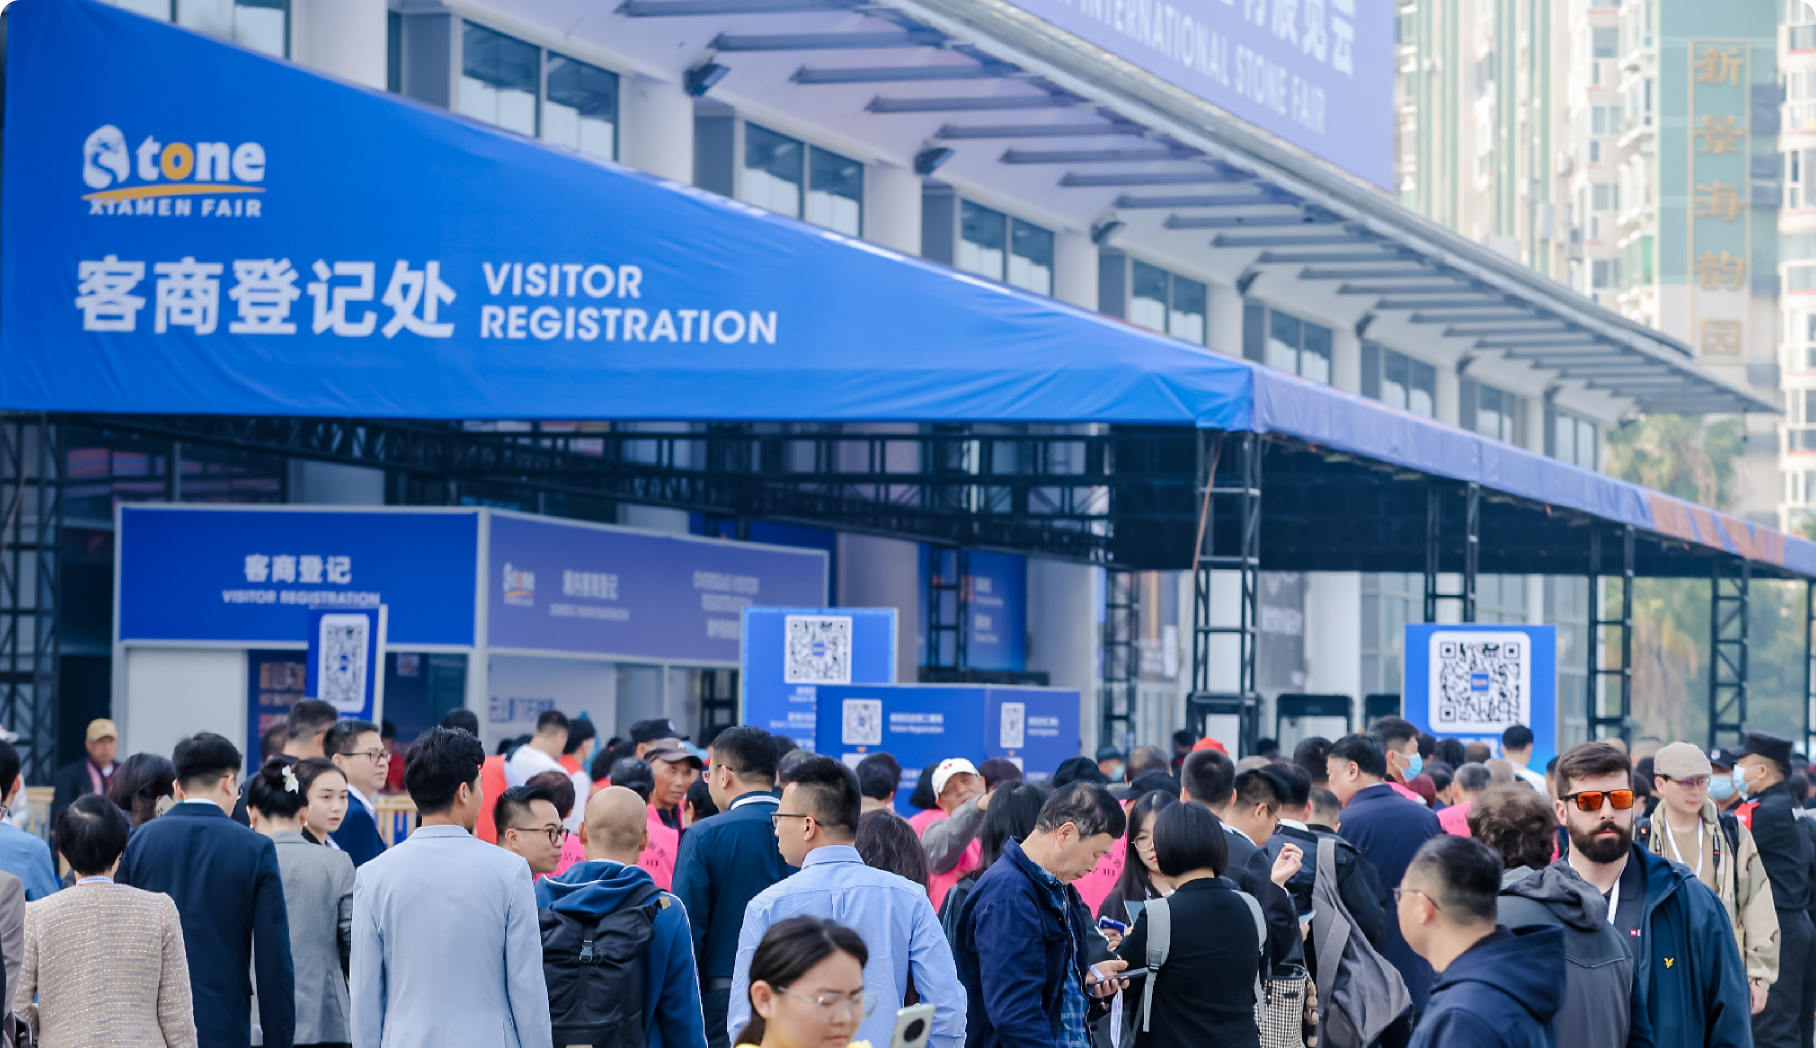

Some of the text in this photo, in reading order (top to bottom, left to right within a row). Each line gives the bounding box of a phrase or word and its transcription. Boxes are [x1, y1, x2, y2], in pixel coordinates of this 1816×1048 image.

[88, 197, 262, 218] XIAMEN FAIR
[75, 255, 456, 340] 客商登记处
[482, 261, 643, 299] VISITOR
[480, 305, 778, 345] REGISTRATION
[243, 553, 353, 585] 客商登记
[222, 589, 277, 604] VISITOR
